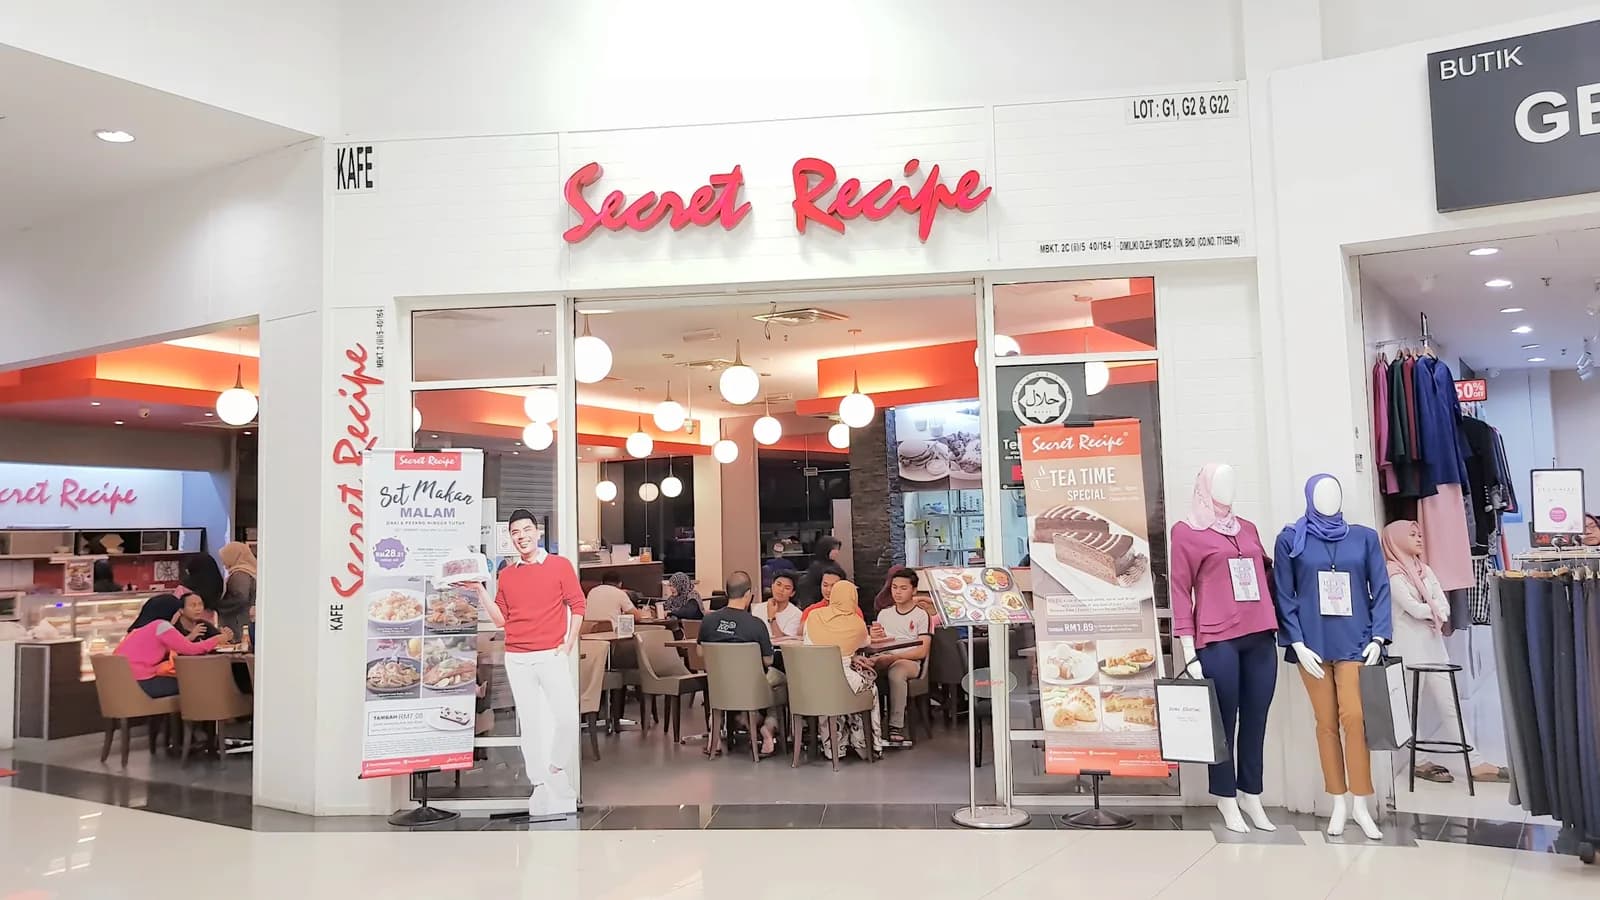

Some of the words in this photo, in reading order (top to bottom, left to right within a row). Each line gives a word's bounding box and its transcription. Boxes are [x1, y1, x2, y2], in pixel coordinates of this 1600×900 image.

[1439, 46, 1523, 80] BUTIK
[1133, 99, 1154, 119] LOT
[1162, 98, 1180, 120] G1,
[1182, 97, 1196, 117] G2
[1199, 96, 1207, 115] &
[1209, 95, 1230, 114] G22
[337, 146, 373, 190] KAFE
[563, 161, 752, 244] Secret
[792, 157, 992, 244] Recipe
[1025, 389, 1060, 407] حلال
[1032, 436, 1074, 453] Secret
[1079, 434, 1124, 453] Recipe
[399, 455, 425, 466] Secret
[428, 455, 455, 467] Recipe
[1049, 469, 1077, 487] TEA
[1080, 467, 1116, 485] TIME
[60, 478, 137, 515] Recipe
[380, 483, 411, 508] Set
[413, 479, 474, 505] Makan
[1067, 488, 1106, 502] SPECIAL
[400, 508, 456, 518] MALAM
[329, 604, 343, 631] KAFE
